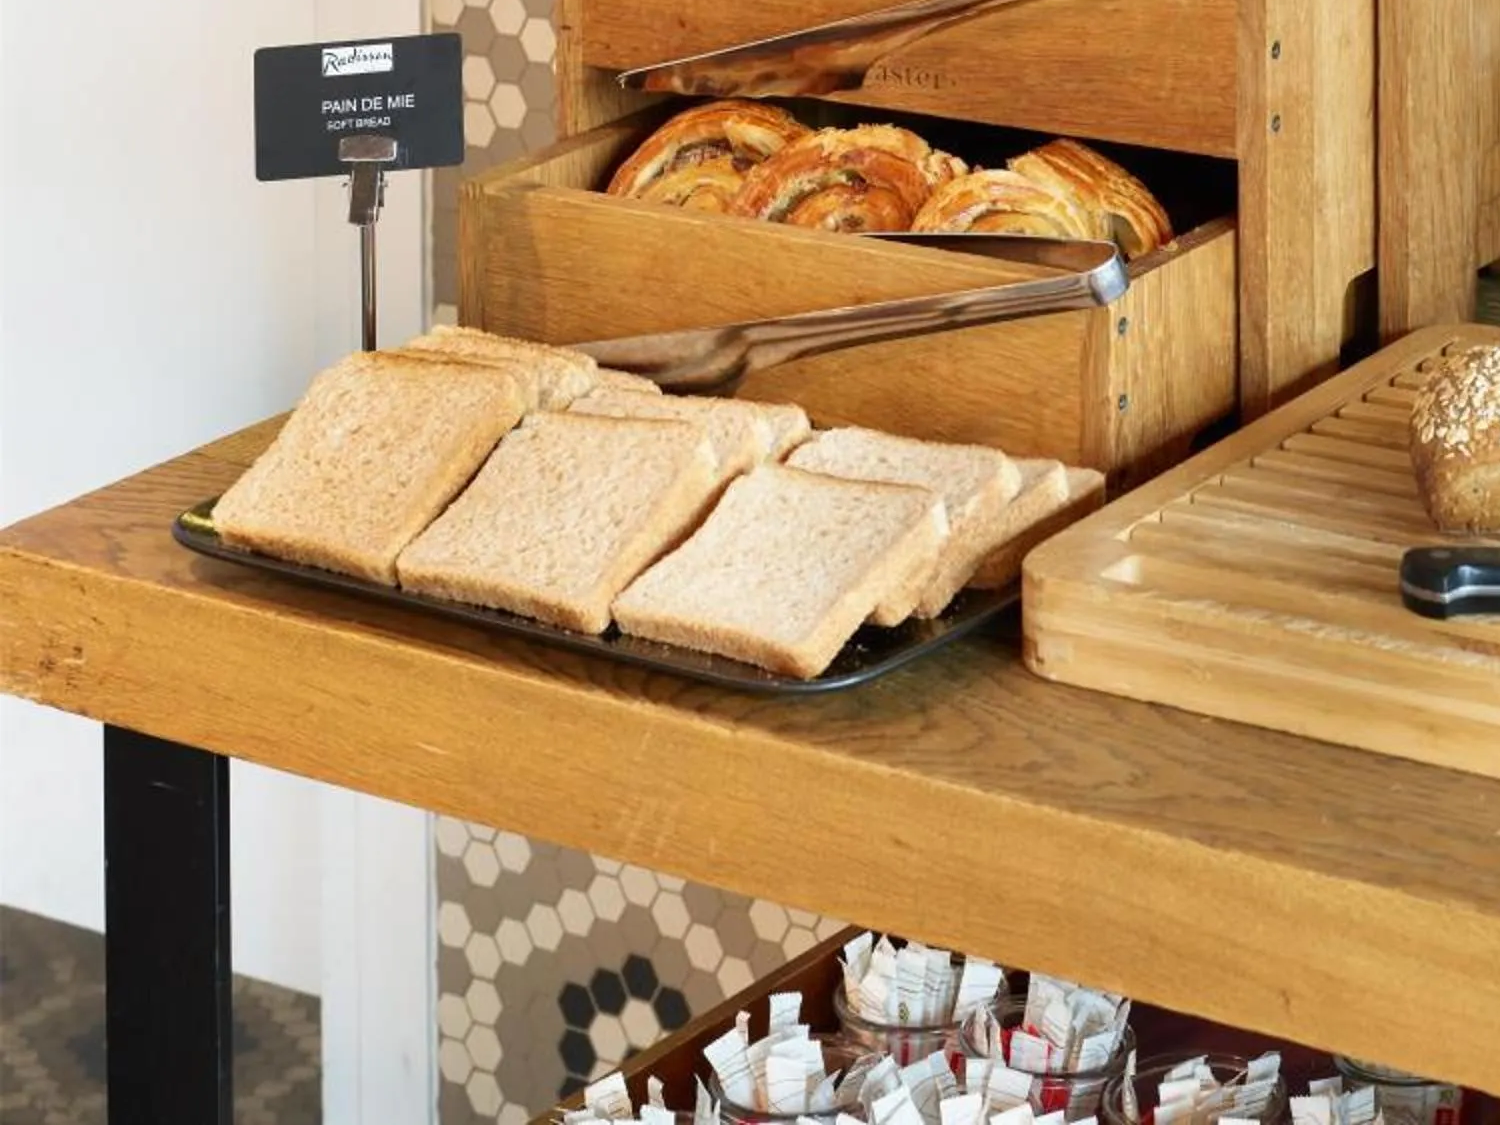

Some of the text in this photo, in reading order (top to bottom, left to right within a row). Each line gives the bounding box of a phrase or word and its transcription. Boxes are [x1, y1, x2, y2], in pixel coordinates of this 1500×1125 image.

[322, 47, 392, 74] Radisson
[875, 65, 945, 90] aster
[321, 93, 415, 114] PAIN DE MIE
[326, 116, 391, 130] SOFT BREAD
